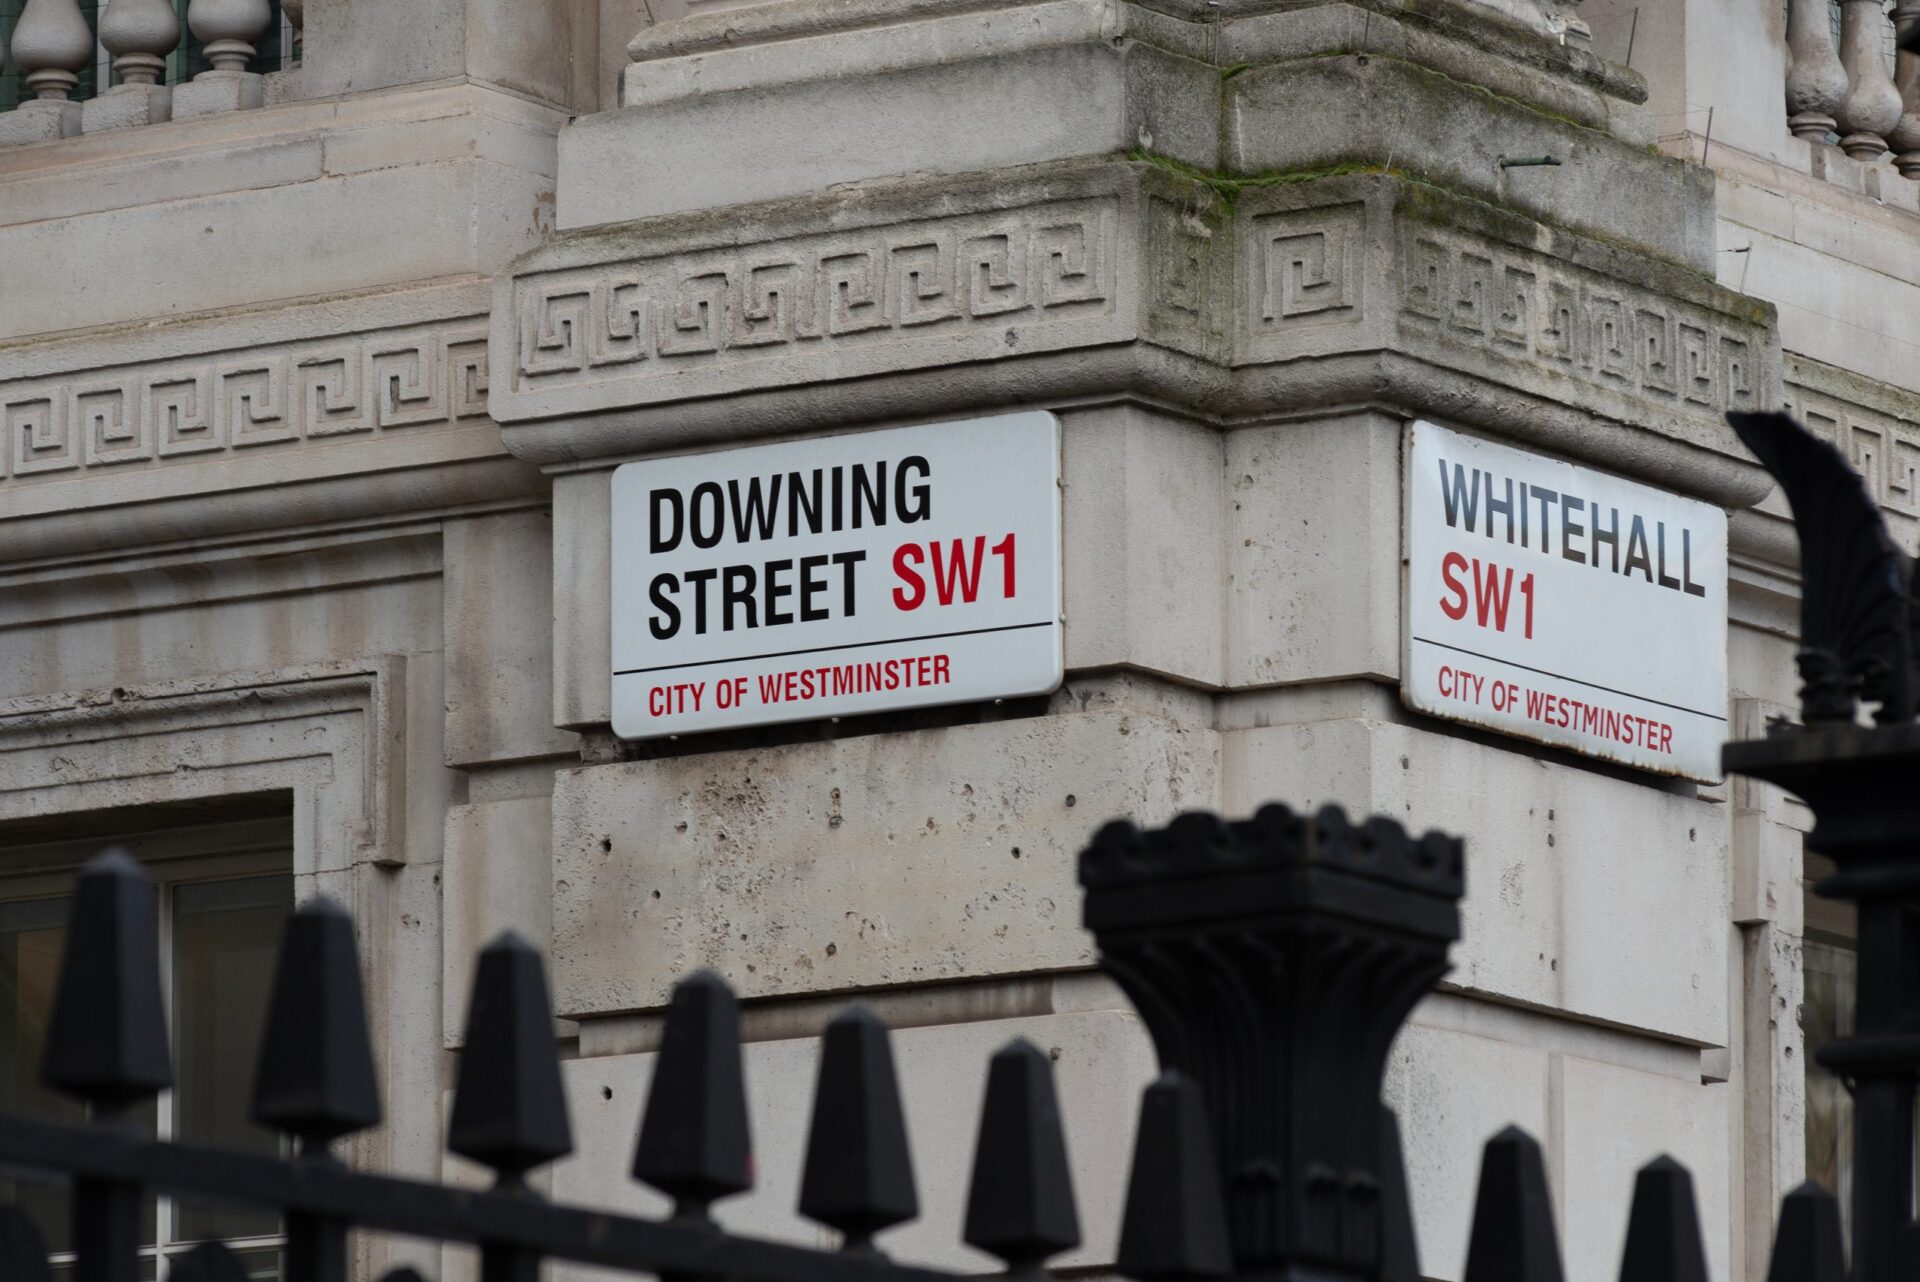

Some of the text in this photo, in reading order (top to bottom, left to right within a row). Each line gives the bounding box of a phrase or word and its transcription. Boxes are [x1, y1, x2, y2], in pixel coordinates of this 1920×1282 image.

[649, 455, 931, 554] DOWNING
[1439, 458, 1706, 598] WHITEHALL
[649, 532, 1016, 641] STREET SW1
[1439, 551, 1535, 640] SW1
[648, 654, 951, 718] CITY OF WESTMINSTER
[1438, 665, 1673, 754] CITY OF WESTMINSTER
